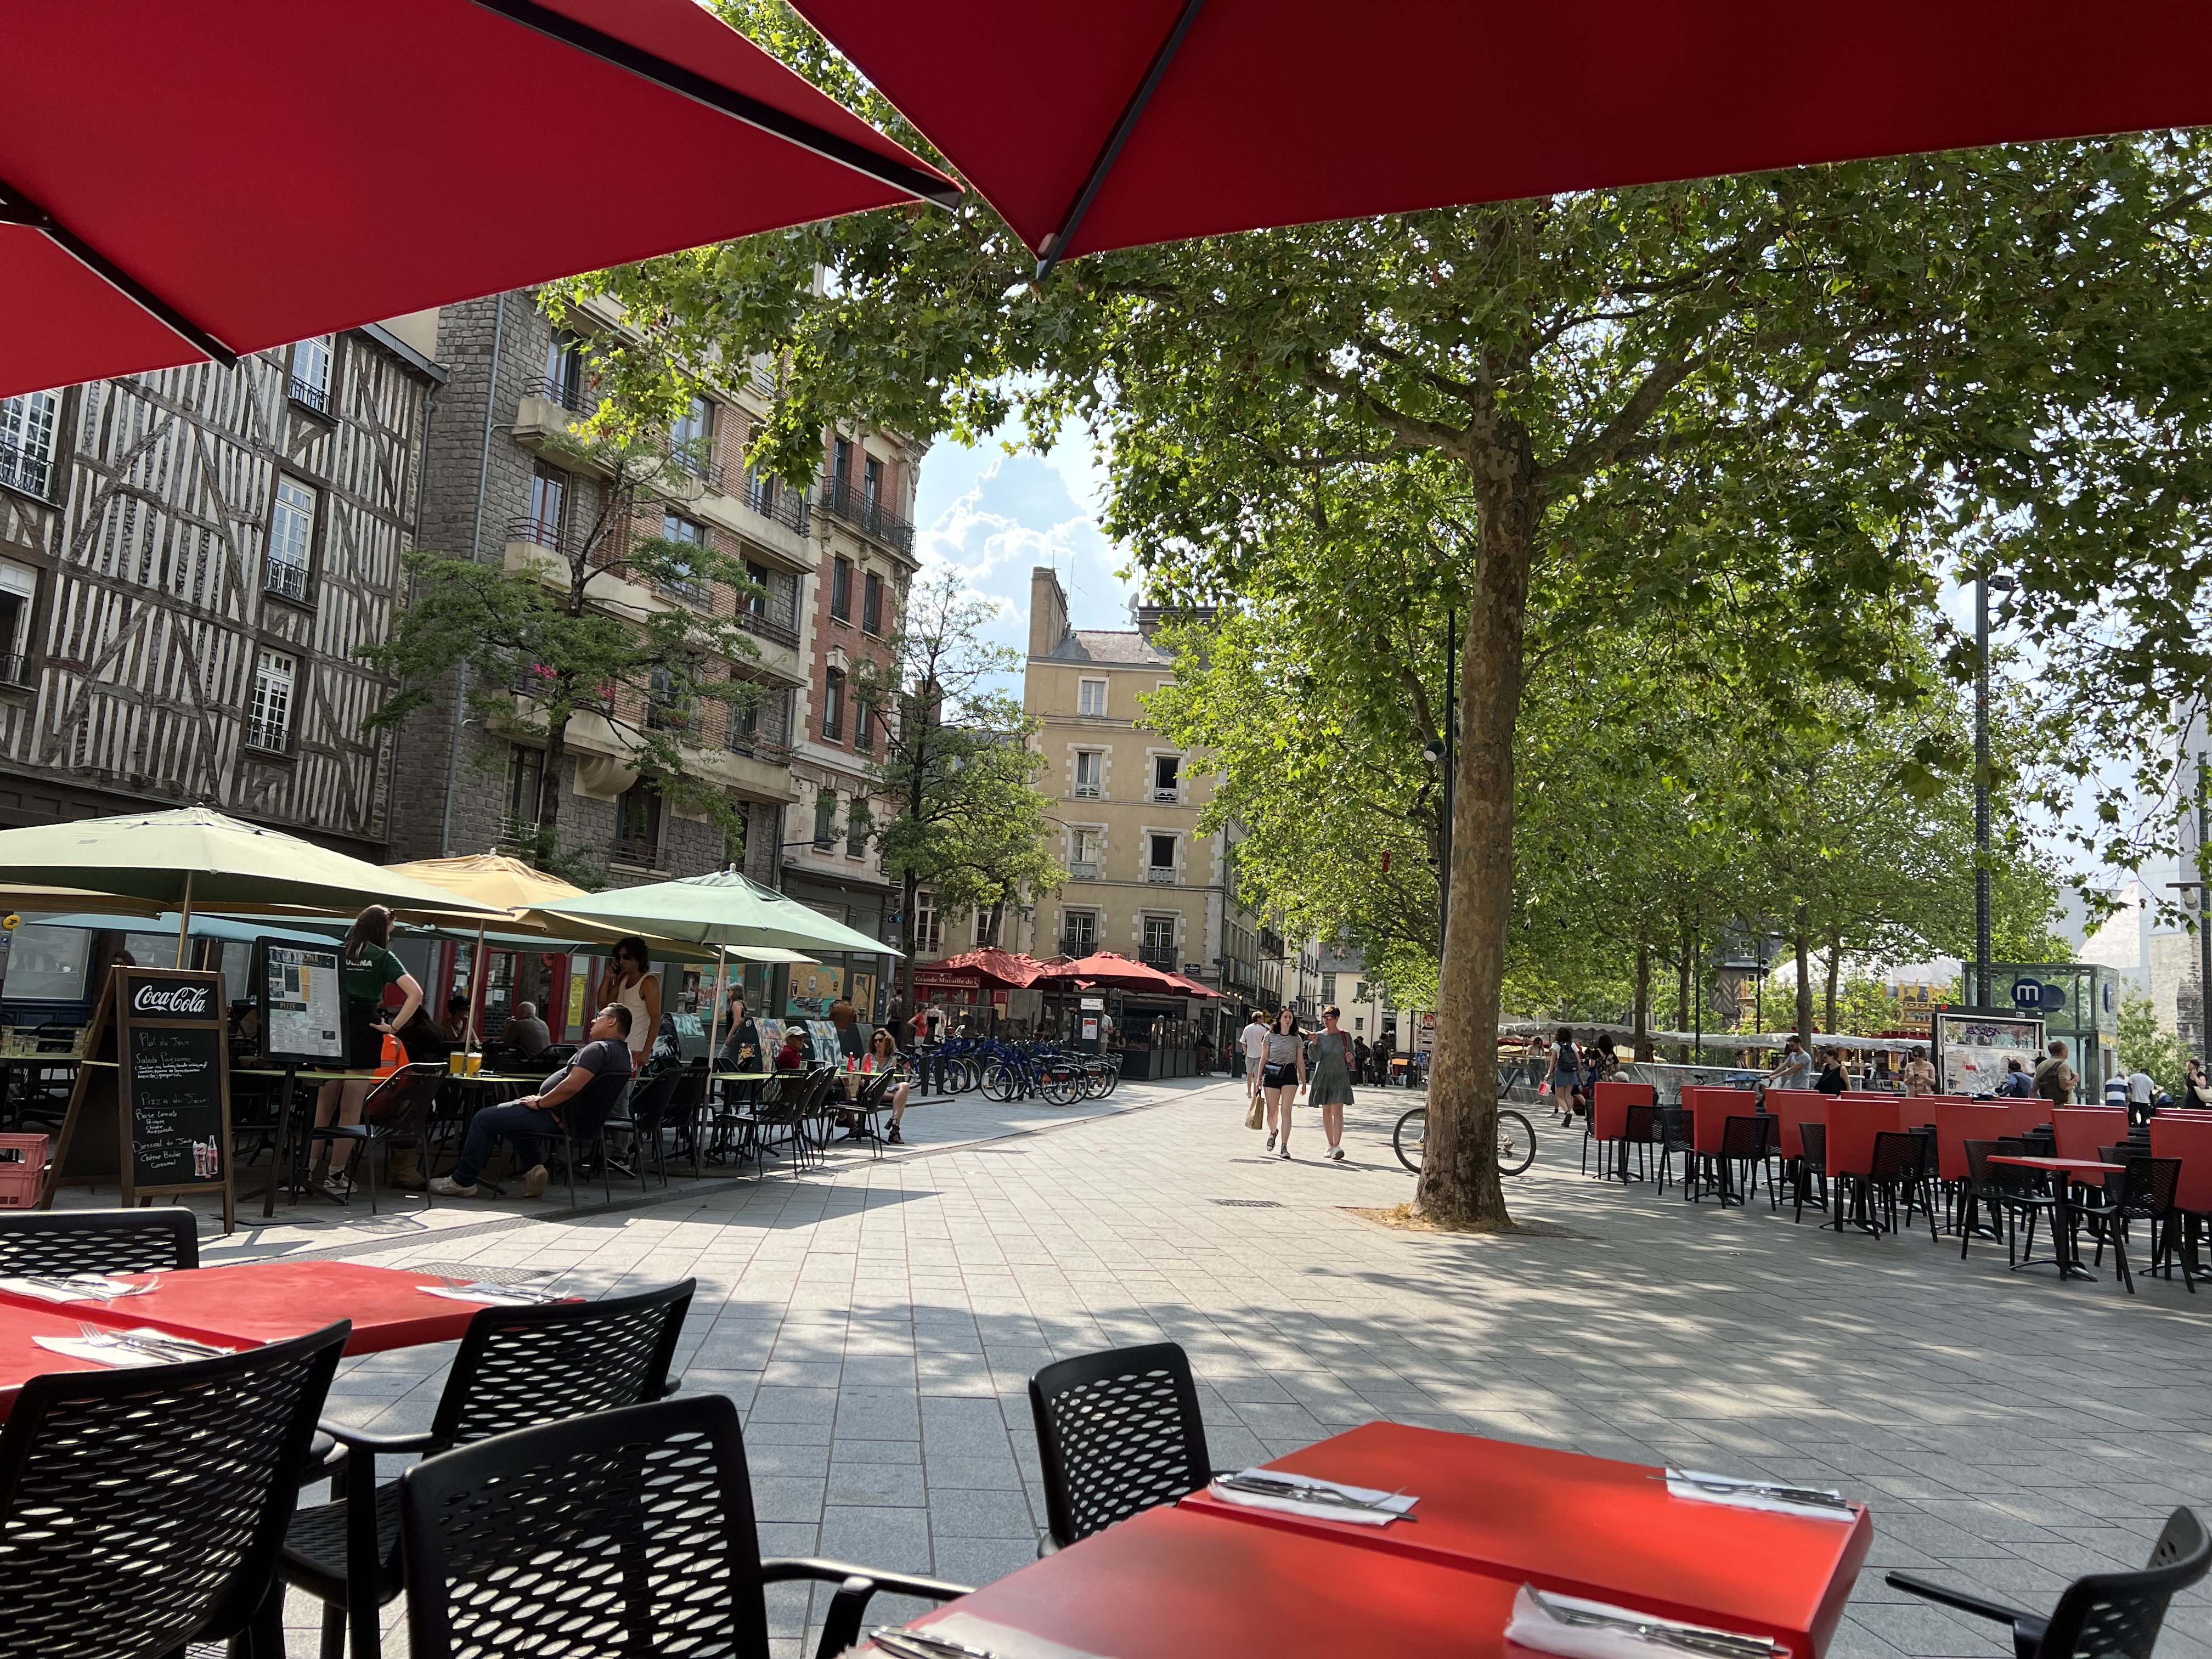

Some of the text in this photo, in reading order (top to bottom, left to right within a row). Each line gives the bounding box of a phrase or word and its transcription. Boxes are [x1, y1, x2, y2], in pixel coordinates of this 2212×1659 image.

[134, 985, 209, 1012] Coca-Cola
[2017, 985, 2039, 1001] m
[139, 1032, 156, 1046] Plat
[160, 1037, 168, 1046] du
[136, 1053, 157, 1063] Salade
[141, 1092, 168, 1105] Pizza
[173, 1093, 182, 1103] du
[136, 1109, 154, 1121] Base
[151, 1159, 176, 1169] Caramel
